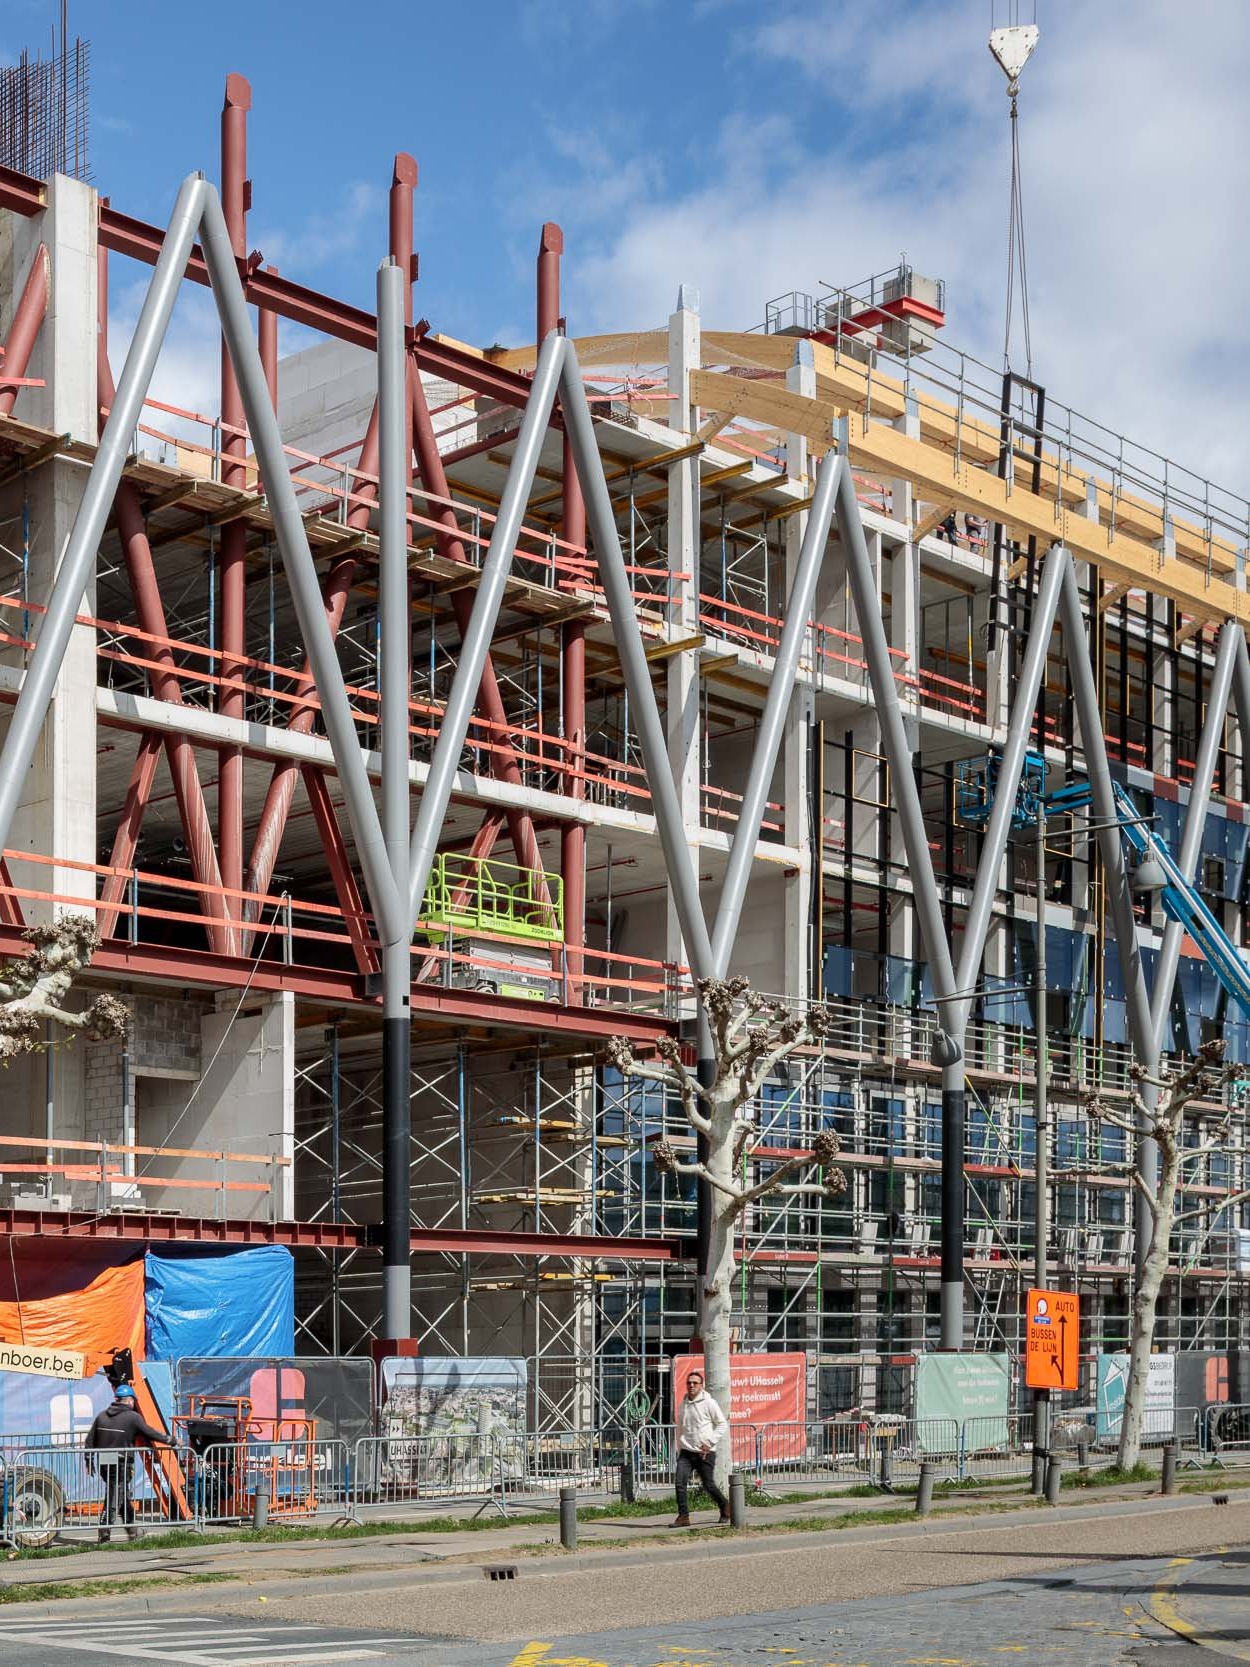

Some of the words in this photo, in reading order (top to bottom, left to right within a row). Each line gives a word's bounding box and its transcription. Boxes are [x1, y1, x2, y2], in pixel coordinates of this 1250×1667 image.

[1055, 1300, 1075, 1313] AUTO
[1031, 1328, 1057, 1341] BUSSEN
[1030, 1341, 1039, 1352] DE
[1042, 1342, 1057, 1354] LIJN
[749, 1375, 784, 1387] UHasselt
